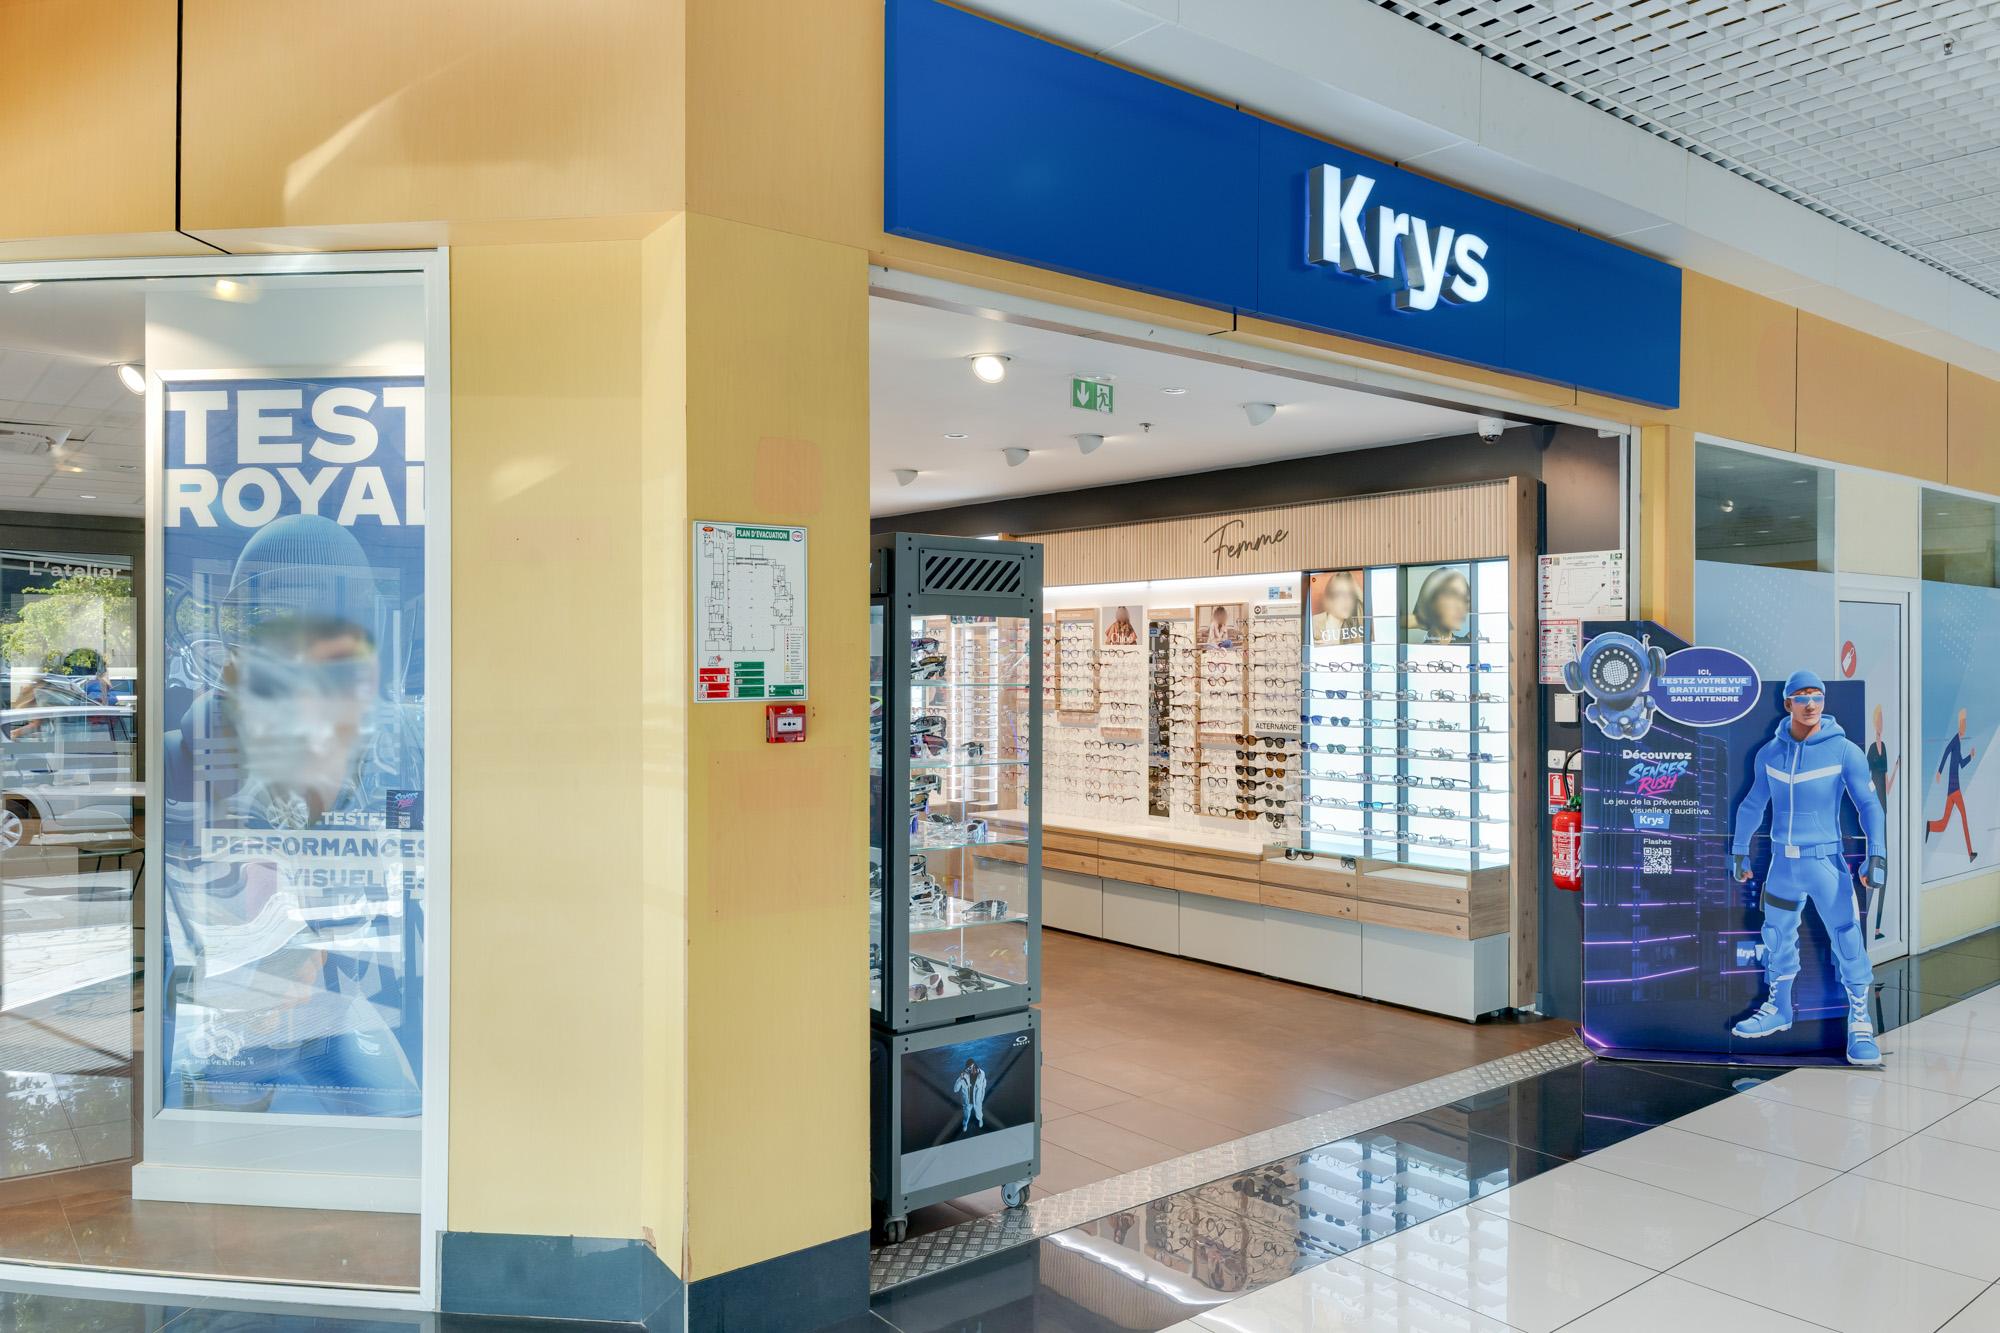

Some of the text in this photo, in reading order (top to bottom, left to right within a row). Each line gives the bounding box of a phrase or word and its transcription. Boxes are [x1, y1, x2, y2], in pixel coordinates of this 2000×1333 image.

[1315, 163, 1489, 311] Krys
[165, 387, 425, 465] TEST
[736, 529, 751, 538] PLAN
[1203, 519, 1289, 571] Femme
[29, 561, 122, 578] L'atelier
[1321, 625, 1364, 641] GUESS
[1697, 668, 1712, 676] ICI,
[1661, 677, 1696, 685] TESTEZ
[1697, 677, 1727, 685] VOTRE
[1669, 686, 1741, 694] GRATUITEMENT
[1670, 695, 1740, 703] SANS ATTENDRE
[1255, 722, 1298, 731] ALTERNANCE
[1622, 749, 1693, 760] Découvrez
[1625, 760, 1688, 785] SENSES
[1636, 773, 1679, 796] RUSH
[1614, 798, 1629, 807] jeu
[1630, 798, 1642, 806] de
[1643, 798, 1652, 806] la
[1653, 798, 1700, 809] prévention
[1629, 806, 1712, 816] visuelle et auditive.
[1639, 815, 1665, 826] Krys
[1643, 838, 1672, 846] Flashez
